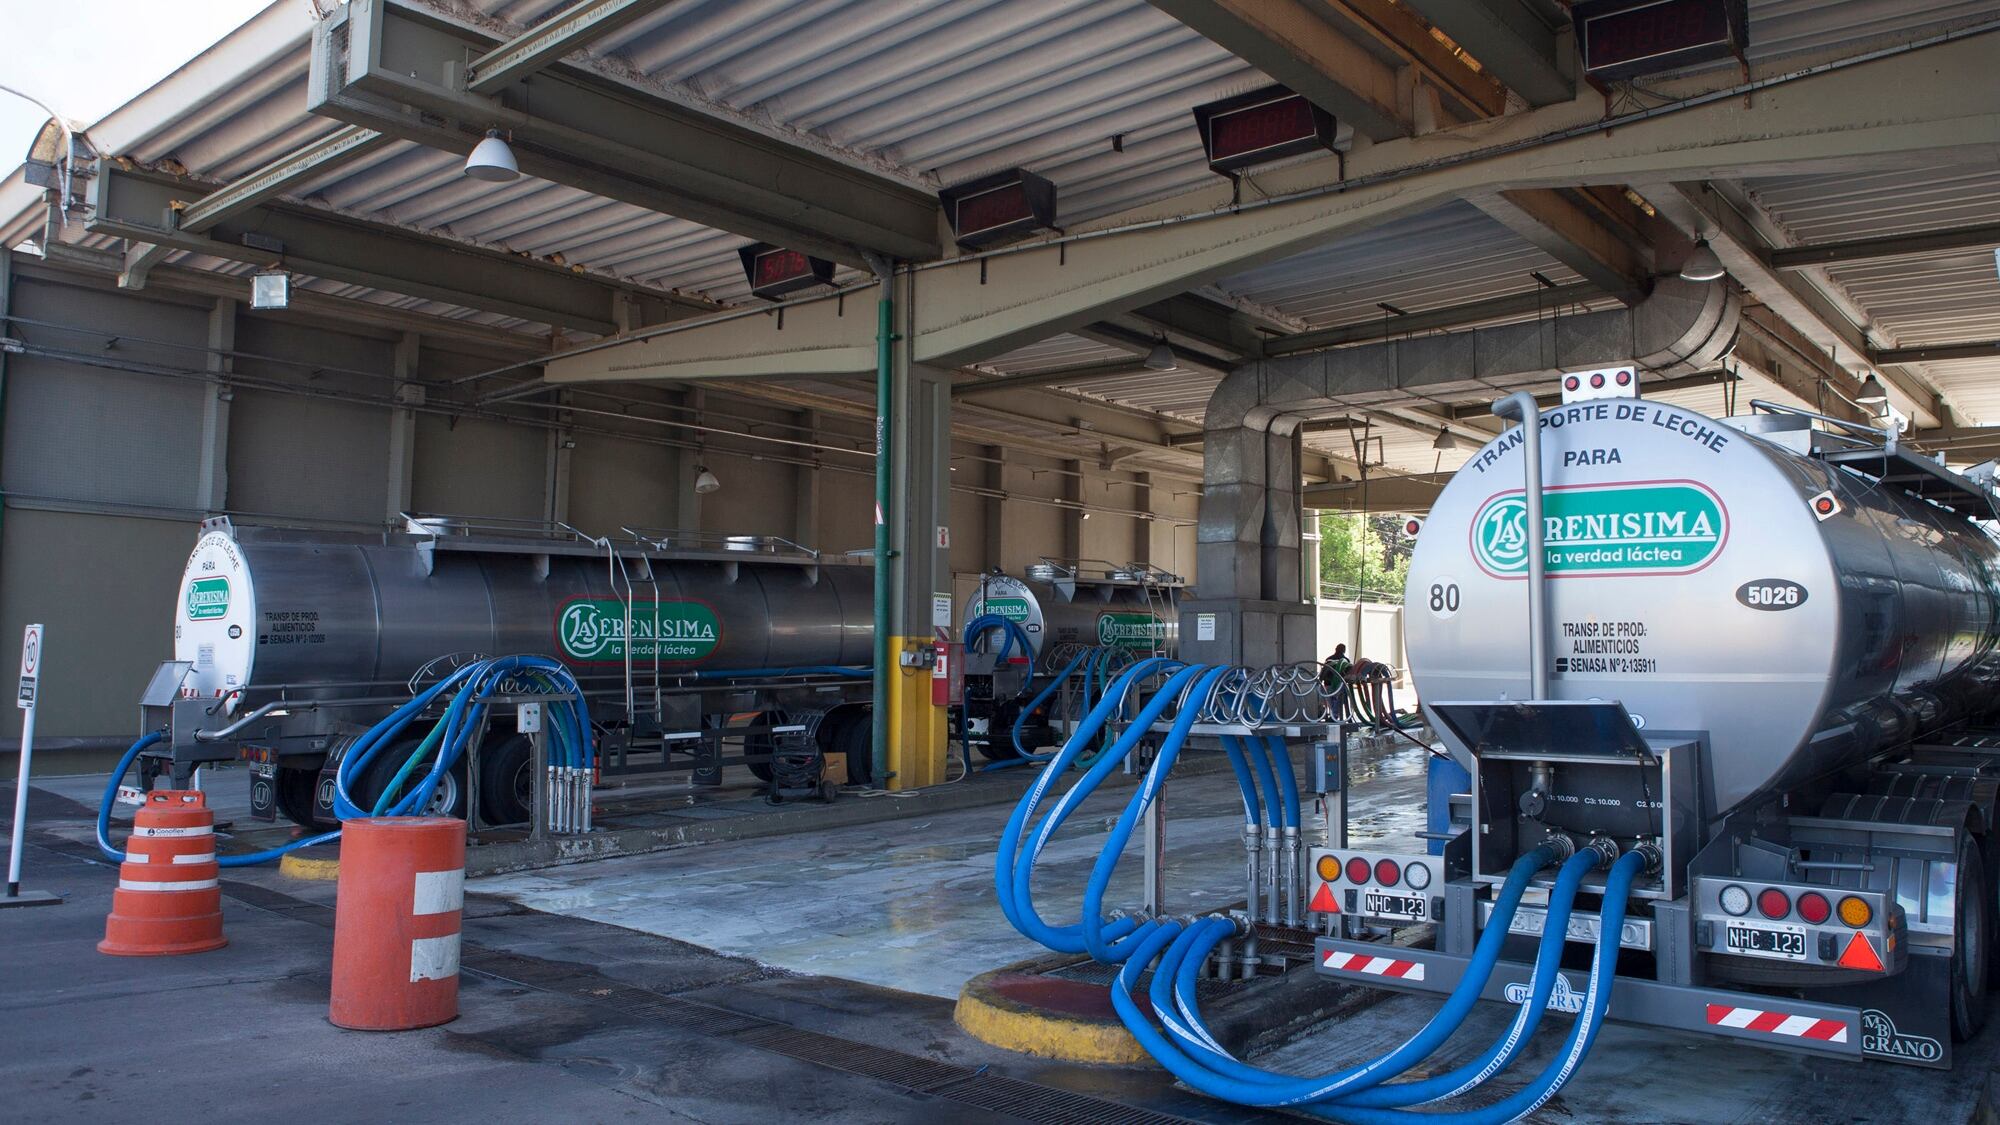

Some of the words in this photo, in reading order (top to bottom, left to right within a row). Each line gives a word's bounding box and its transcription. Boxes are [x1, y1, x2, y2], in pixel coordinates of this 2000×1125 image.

[1472, 404, 1608, 473] TRANPORTE
[1616, 405, 1647, 422] DE
[1652, 409, 1728, 453] LECHE
[1564, 448, 1621, 467] PARA
[1548, 551, 1562, 564] la
[1566, 548, 1622, 563] verdad
[1627, 546, 1682, 562] láctea
[1430, 583, 1460, 612] 80
[1748, 586, 1798, 605] 5026
[292, 612, 300, 621] DE
[272, 623, 315, 632] ALIMENTICIOS
[1563, 622, 1600, 637] TRANSP.
[1602, 622, 1615, 637] DE
[269, 634, 294, 644] SENASA
[1573, 639, 1639, 654] ALIMENTICIOS
[27, 641, 36, 662] 10
[611, 645, 621, 654] la
[625, 644, 661, 654] erdad
[664, 643, 696, 654] láctea
[1570, 658, 1607, 673] SENASA
[1598, 798, 1621, 806] 10.000
[1367, 895, 1391, 913] NHC
[1400, 898, 1424, 916] 123
[1729, 927, 1760, 949] NHC
[1771, 932, 1803, 954] 123
